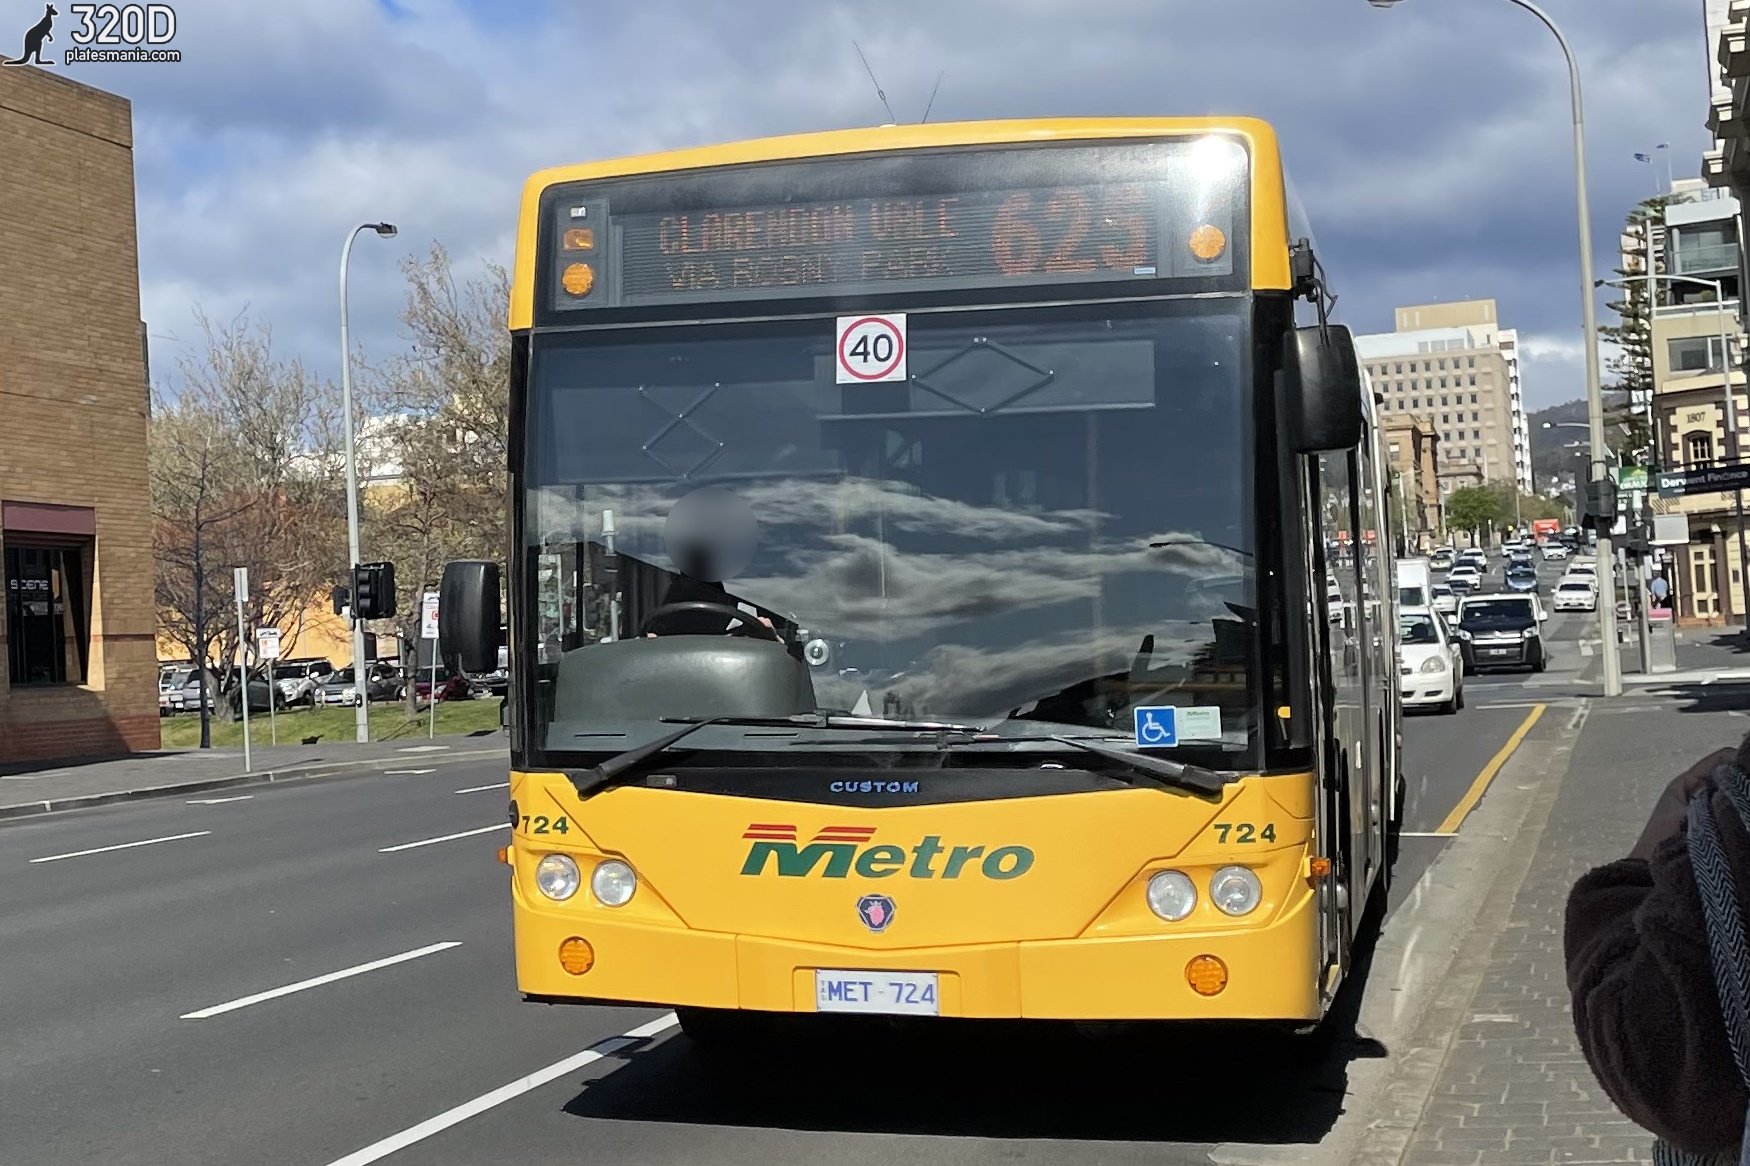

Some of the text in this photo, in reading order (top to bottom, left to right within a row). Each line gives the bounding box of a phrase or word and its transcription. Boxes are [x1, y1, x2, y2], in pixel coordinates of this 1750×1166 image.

[659, 197, 960, 254] CLARENDON VALE
[992, 185, 1149, 278] 625
[664, 260, 720, 291] VIA
[849, 333, 893, 363] 40
[1686, 411, 1706, 424] 1807
[829, 780, 919, 793] CUSTOM
[522, 815, 569, 835] 724
[1213, 823, 1277, 844] 724
[740, 823, 1035, 880] Metro
[828, 980, 935, 1004] MET 724
